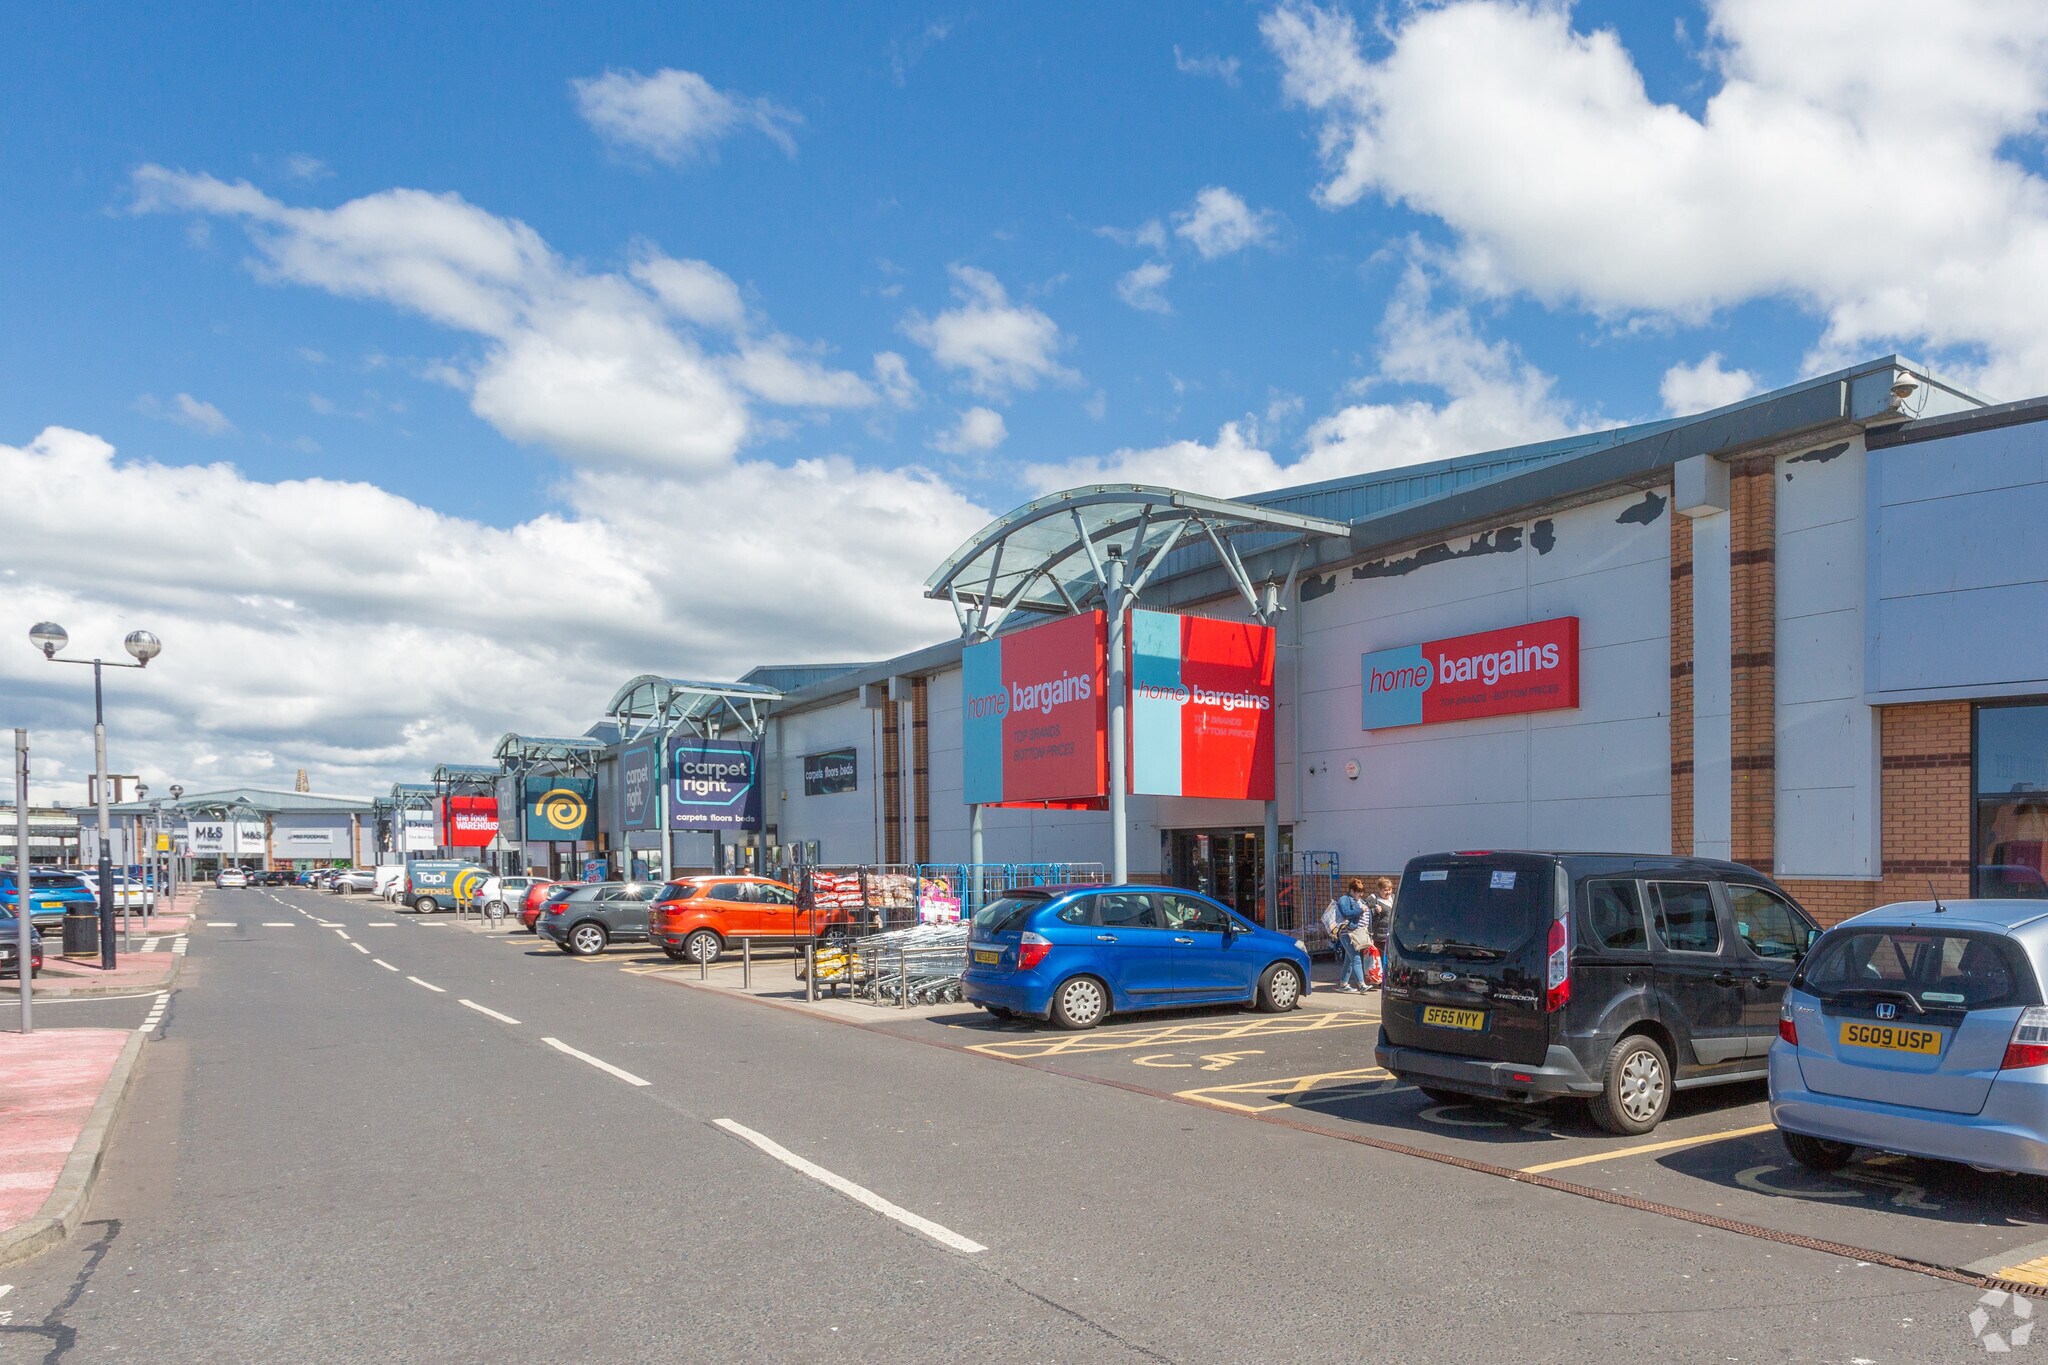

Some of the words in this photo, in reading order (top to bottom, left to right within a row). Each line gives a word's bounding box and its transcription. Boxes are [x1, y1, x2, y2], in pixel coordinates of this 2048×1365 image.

[1369, 664, 1428, 694] home
[1439, 640, 1559, 686] bargains
[966, 692, 1006, 720] home
[1012, 669, 1091, 715] bargains
[1139, 680, 1186, 702] home
[1193, 684, 1271, 712] bargains
[1456, 693, 1487, 706] BRANDS
[1493, 687, 1528, 702] BOTTOM
[1529, 683, 1560, 697] PRICES
[1211, 715, 1243, 727] BRANDS
[1014, 729, 1029, 742] TOP
[1030, 724, 1062, 741] BRANDS
[1194, 728, 1227, 737] BOTTOM
[1014, 746, 1045, 762] BOTTOM
[1046, 741, 1076, 758] PRICES
[626, 763, 649, 785] carpet
[682, 762, 747, 780] carpet
[805, 769, 824, 782] carpets
[825, 766, 839, 778] floors
[840, 763, 854, 776] beds
[683, 776, 732, 796] right.
[456, 813, 470, 822] the
[470, 813, 488, 822] food
[456, 821, 500, 831] WAREHOUS
[676, 813, 708, 823] carpets
[710, 813, 733, 822] floors
[735, 814, 756, 823] beds
[196, 826, 223, 839] M&S
[242, 831, 262, 840] M&S
[417, 871, 447, 885] Tapi
[415, 887, 452, 896] carpets
[1493, 993, 1539, 1002] FREEDOM
[1427, 1008, 1456, 1025] SF65
[1456, 1011, 1479, 1027] NYY
[1847, 1025, 1894, 1045] SG09
[1896, 1030, 1933, 1050] USP
